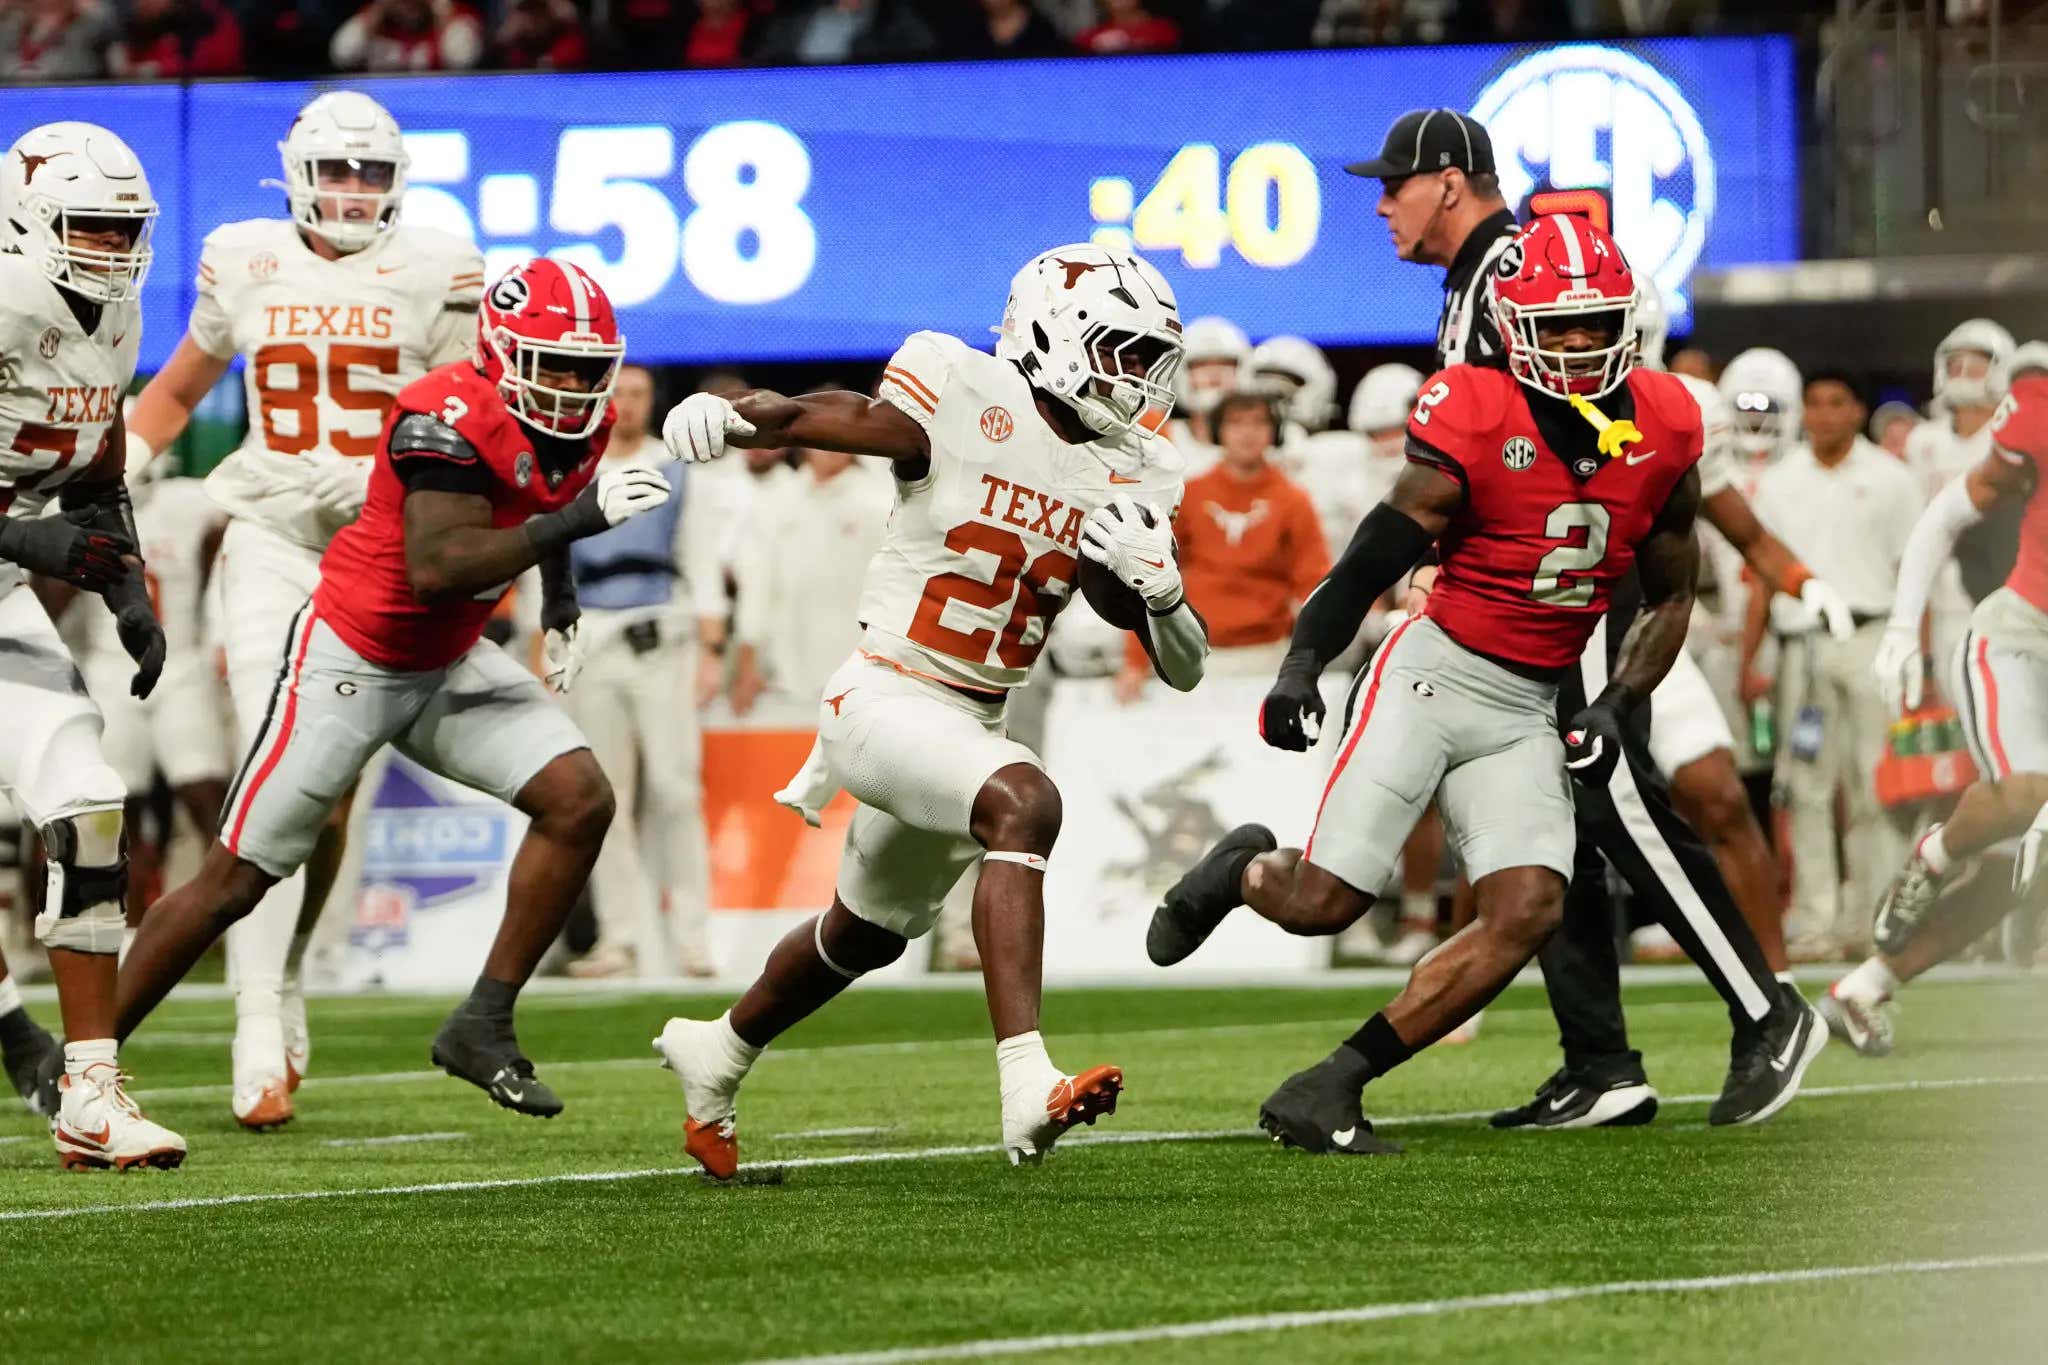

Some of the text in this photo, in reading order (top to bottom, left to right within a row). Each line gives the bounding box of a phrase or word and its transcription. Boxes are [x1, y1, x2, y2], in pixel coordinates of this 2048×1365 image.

[1089, 141, 1321, 268] :40
[265, 305, 392, 340] TEXAS
[45, 383, 118, 424] TEXAS
[255, 342, 399, 458] 85
[1413, 380, 1451, 426] 2
[982, 407, 1013, 441] SEC
[1504, 438, 1535, 470] SEC
[979, 473, 1086, 550] TEXA
[1531, 501, 1612, 608] 2
